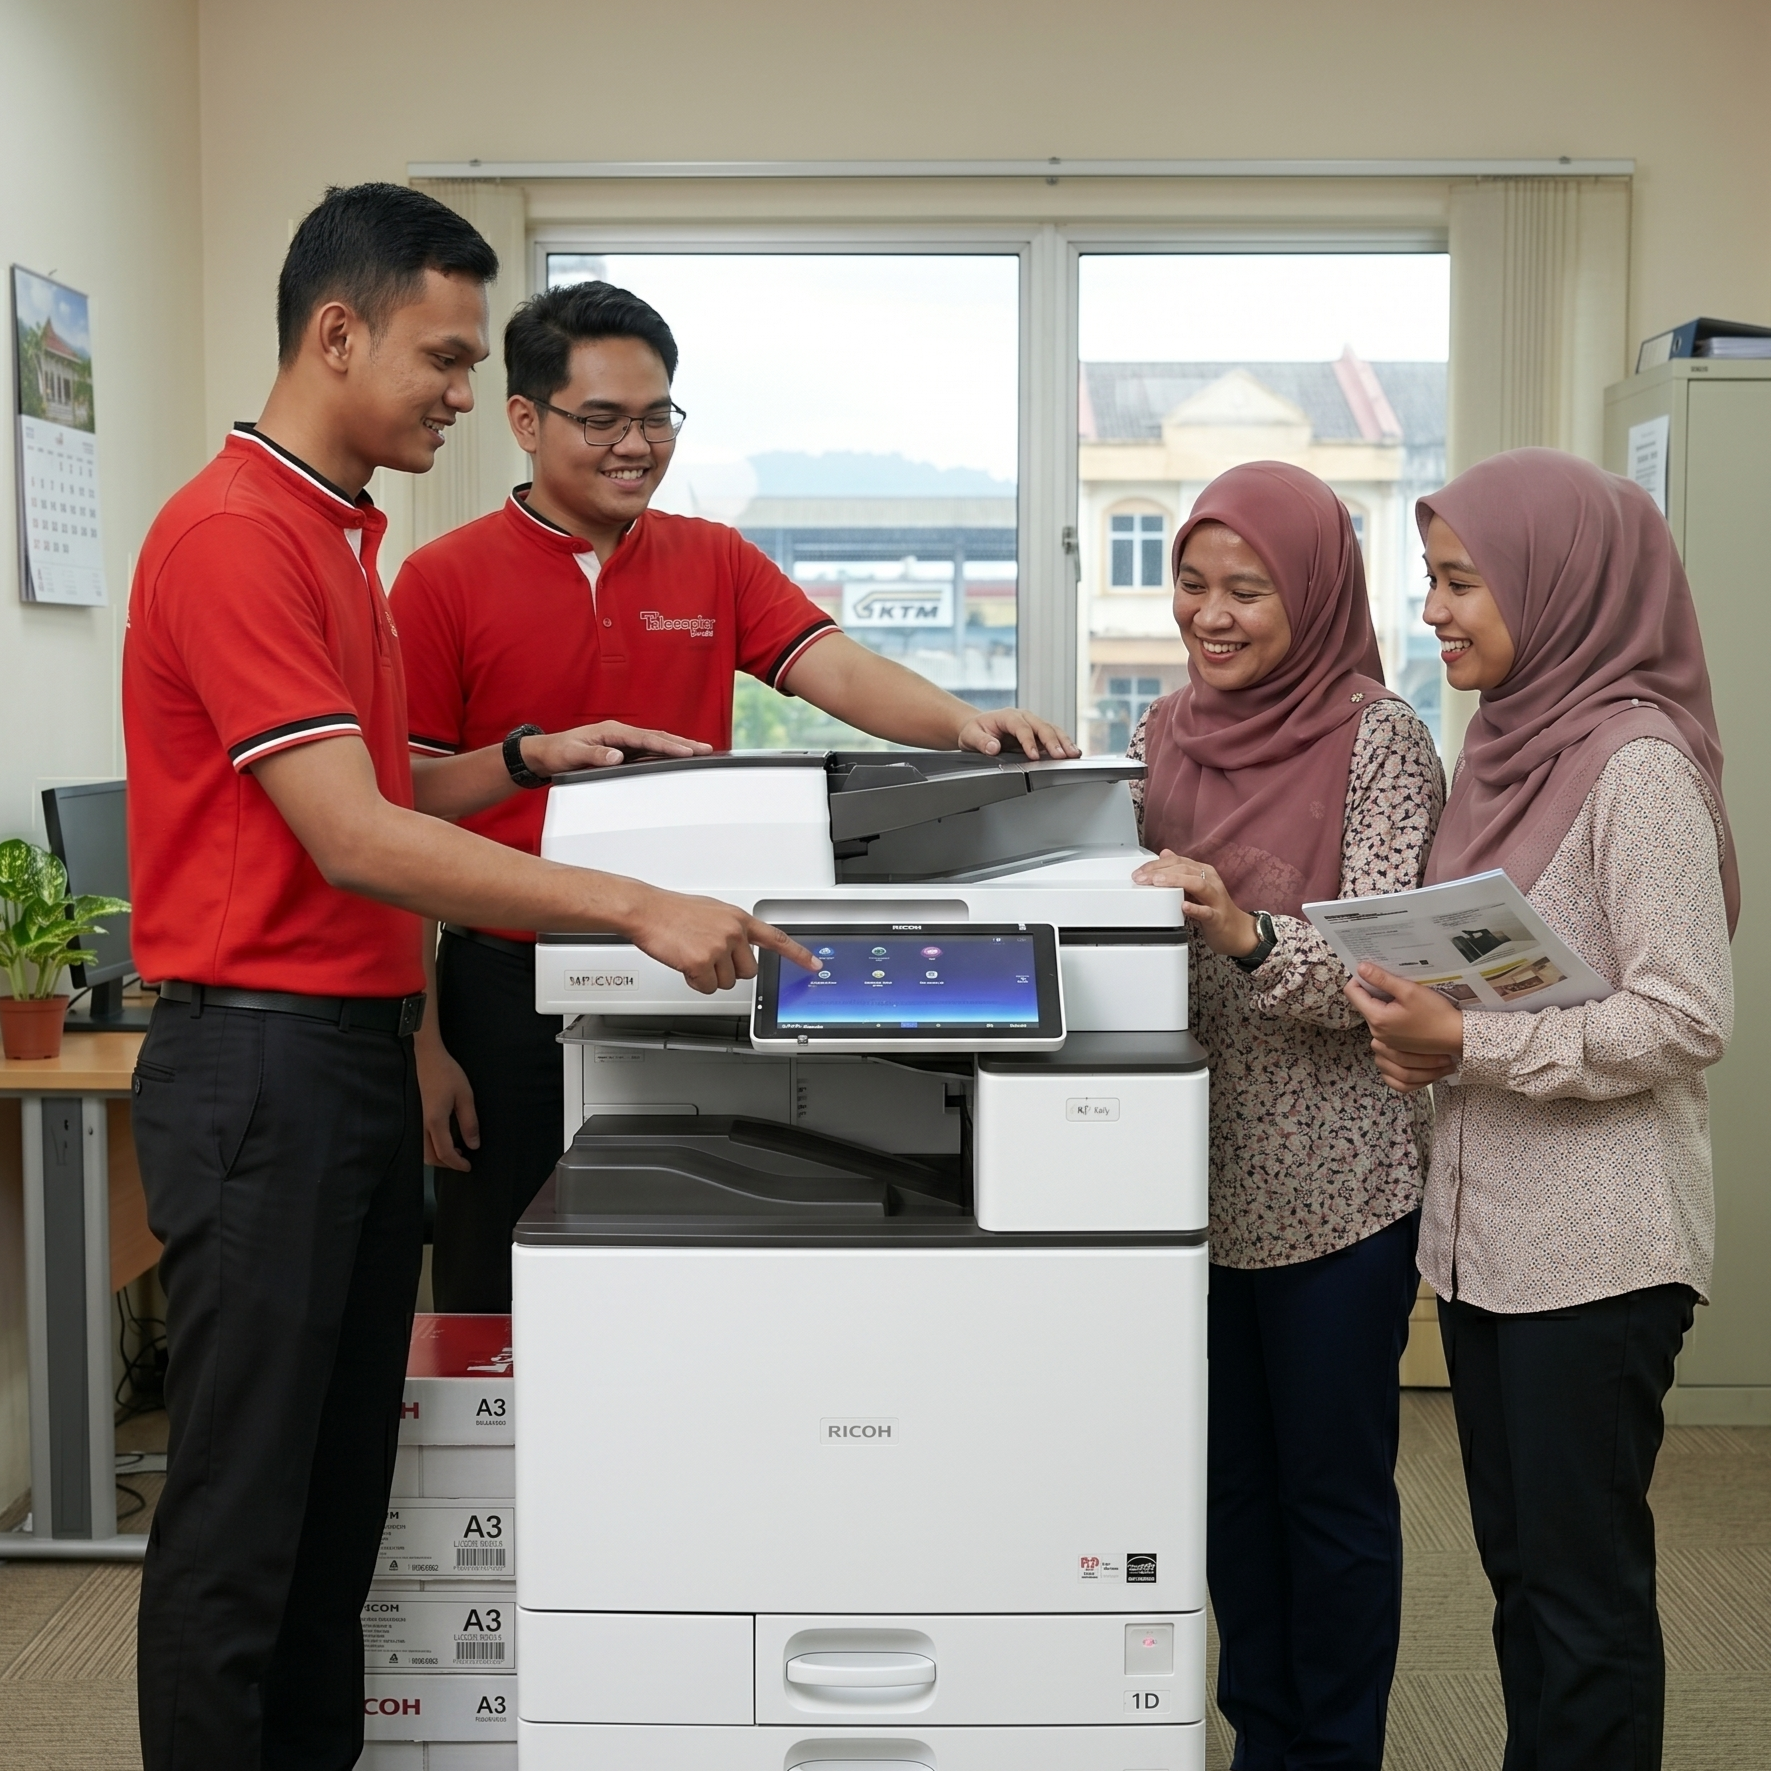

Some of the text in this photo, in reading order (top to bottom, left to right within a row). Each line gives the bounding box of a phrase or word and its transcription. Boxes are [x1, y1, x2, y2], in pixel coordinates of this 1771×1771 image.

[879, 606, 939, 619] KTM
[475, 1398, 506, 1418] A3
[828, 1425, 892, 1438] RICOH
[463, 1514, 503, 1539] A3
[462, 1608, 502, 1633] A3
[364, 1698, 421, 1716] COH
[476, 1695, 507, 1715] A3
[1132, 1692, 1160, 1710] 1D
